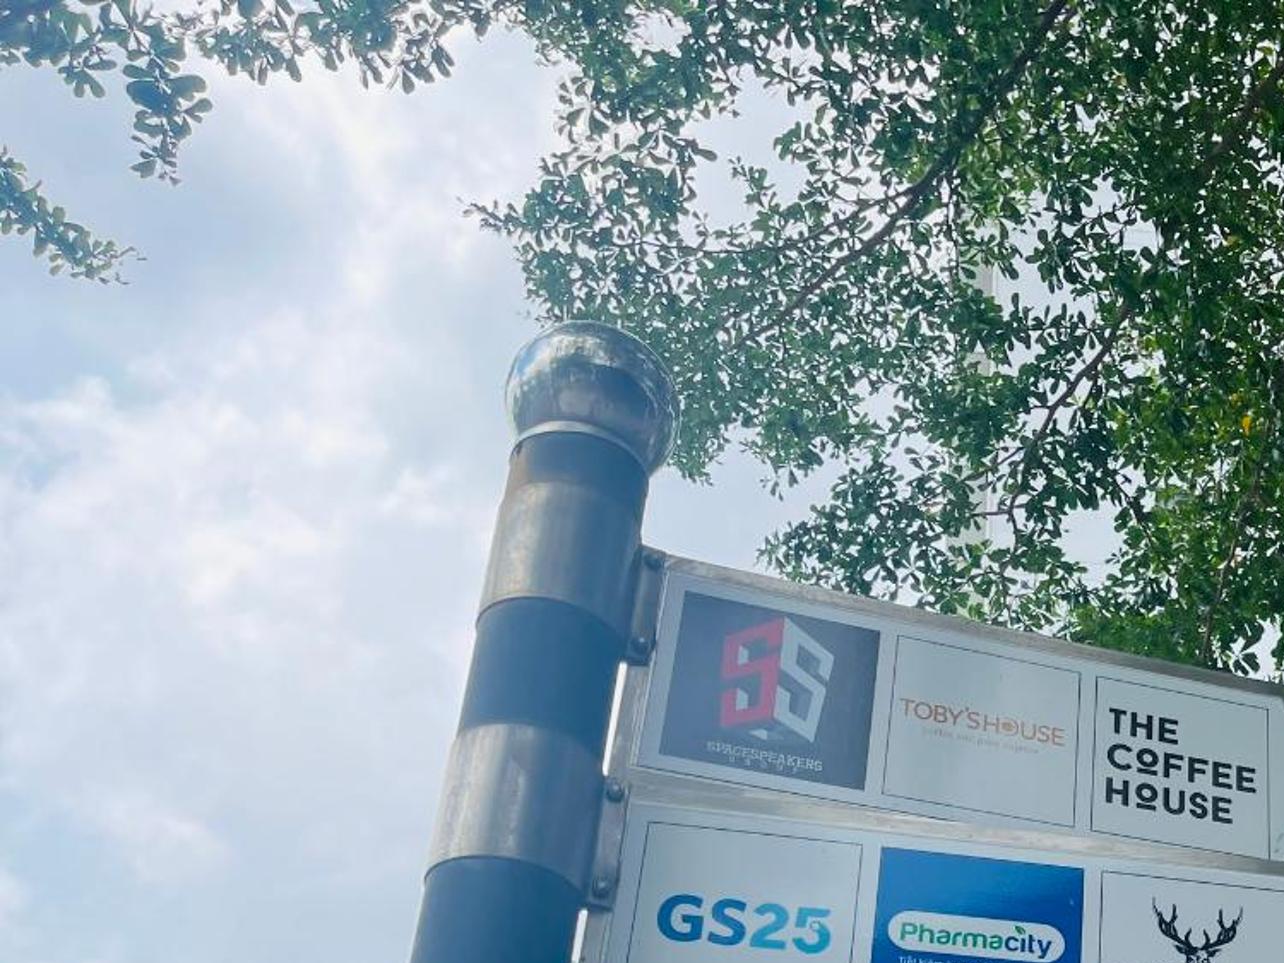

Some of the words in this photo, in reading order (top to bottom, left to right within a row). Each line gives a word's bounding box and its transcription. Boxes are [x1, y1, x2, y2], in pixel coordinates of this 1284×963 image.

[1108, 707, 1179, 745] THE
[1107, 743, 1257, 794] COFFEE
[1105, 776, 1234, 825] HOUSE
[656, 893, 832, 955] GS25
[899, 922, 1053, 960] Pharmacity
